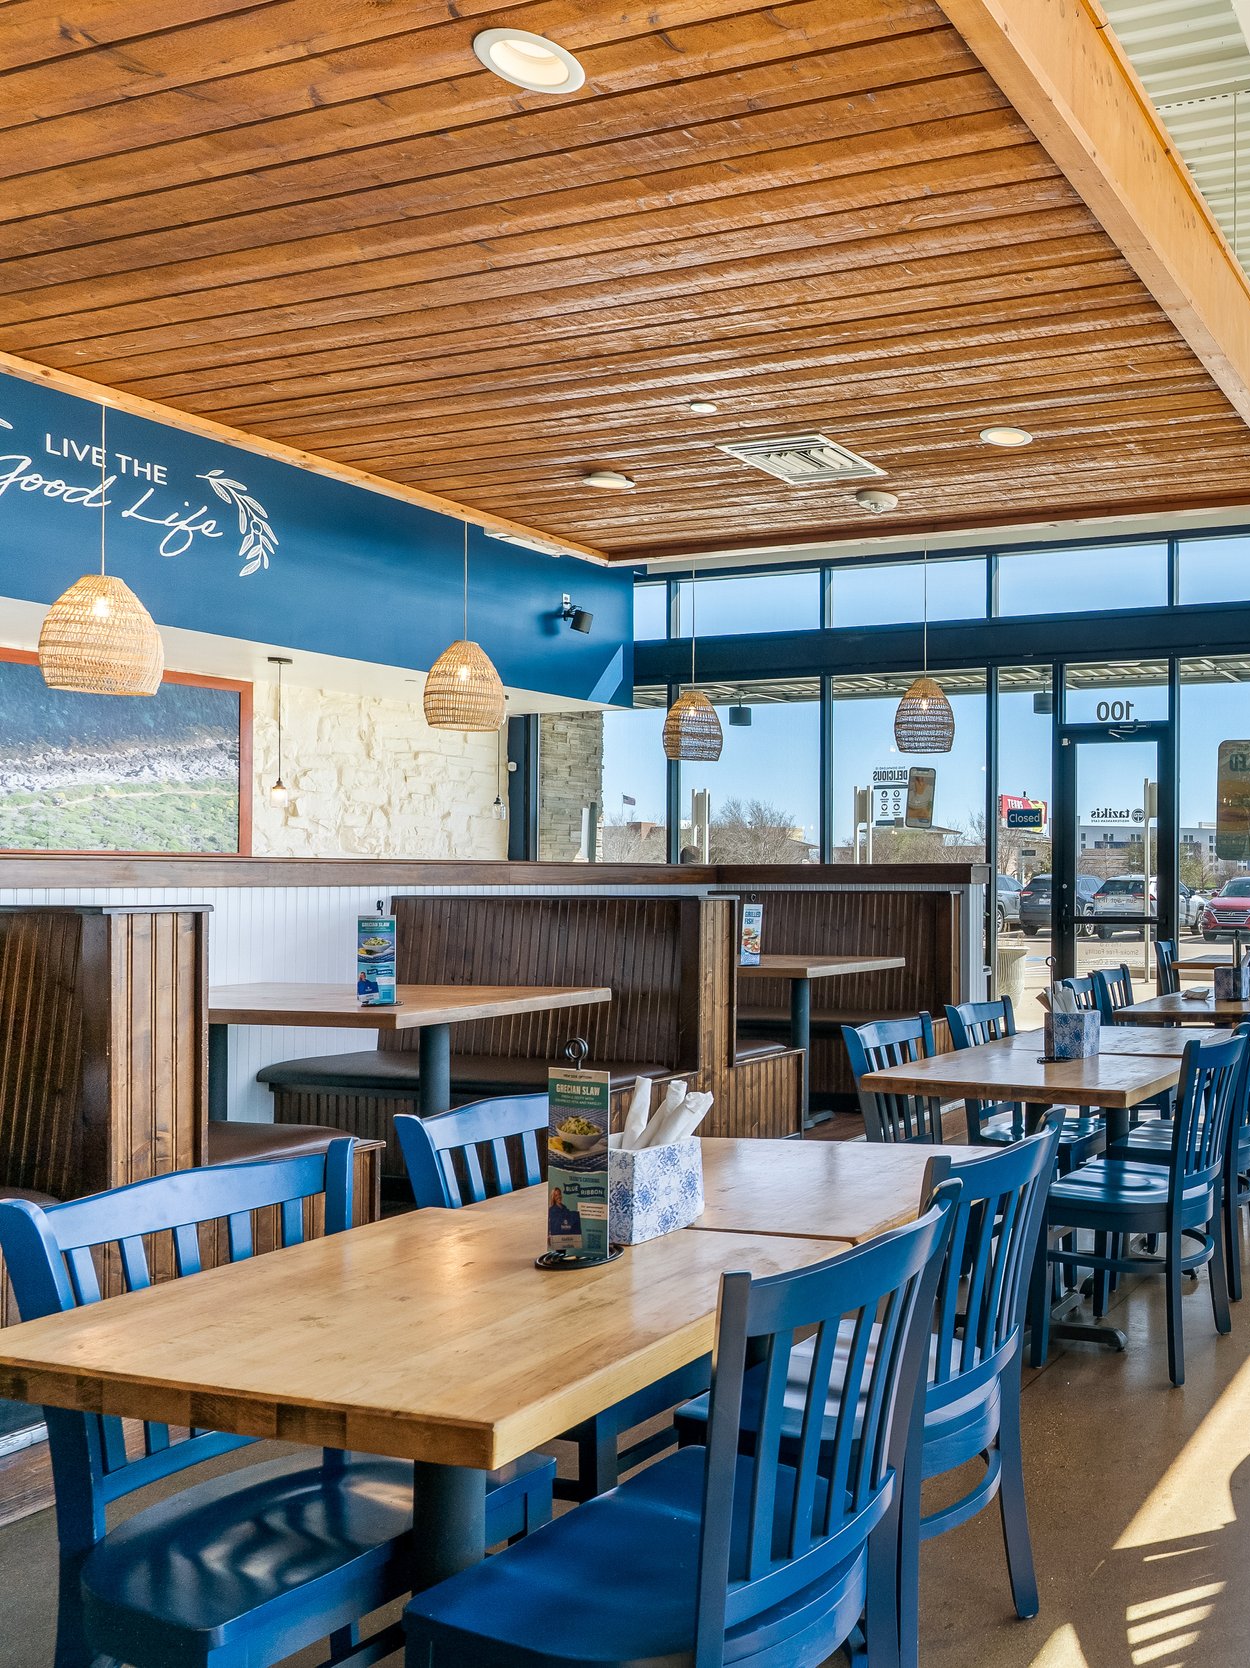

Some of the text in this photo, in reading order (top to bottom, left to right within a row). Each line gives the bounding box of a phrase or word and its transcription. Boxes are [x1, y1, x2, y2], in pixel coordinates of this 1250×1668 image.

[46, 433, 168, 485] LIVE THE
[121, 488, 223, 557] Life
[1009, 813, 1040, 823] Closed
[556, 1083, 600, 1096] GRECIAN SLAW
